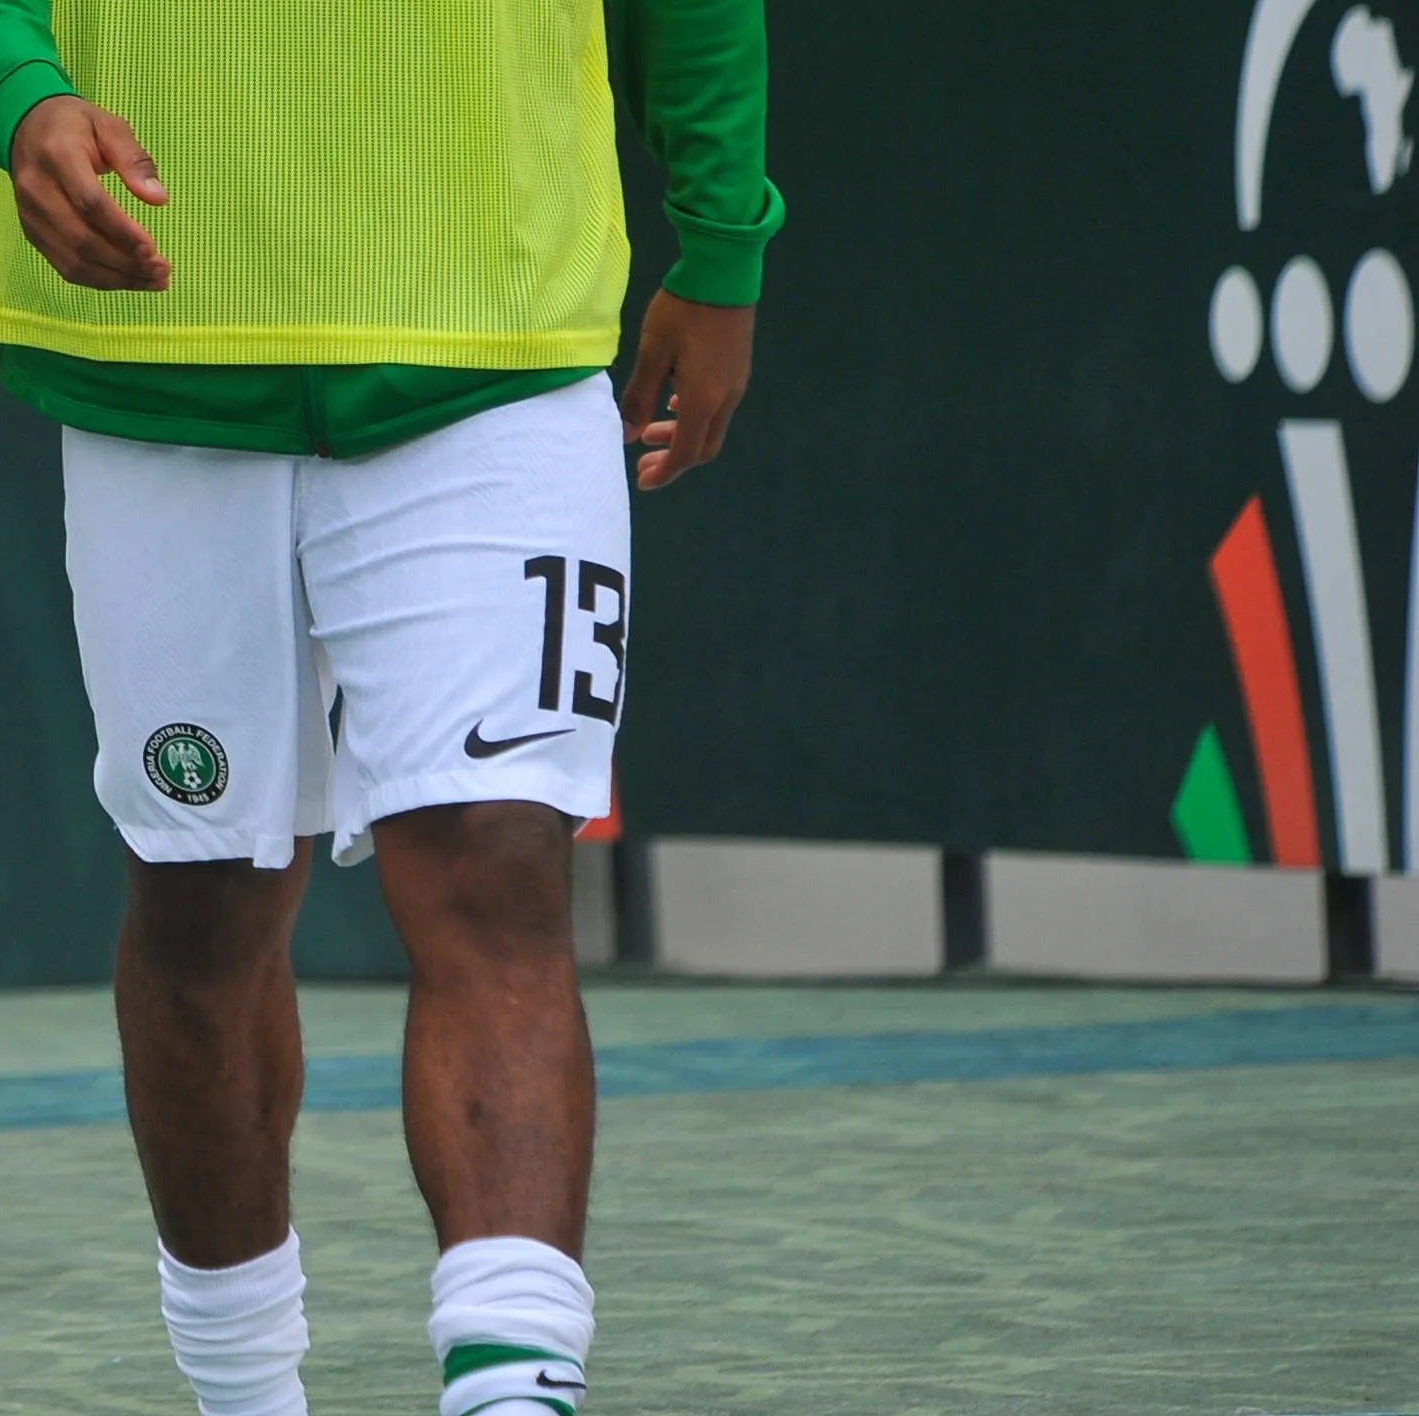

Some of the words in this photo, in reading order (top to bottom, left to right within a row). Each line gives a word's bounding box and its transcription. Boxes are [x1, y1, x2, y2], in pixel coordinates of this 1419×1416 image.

[523, 554, 626, 728] 13
[147, 726, 194, 755] FOOTBALL
[195, 729, 227, 791] FEDERATION
